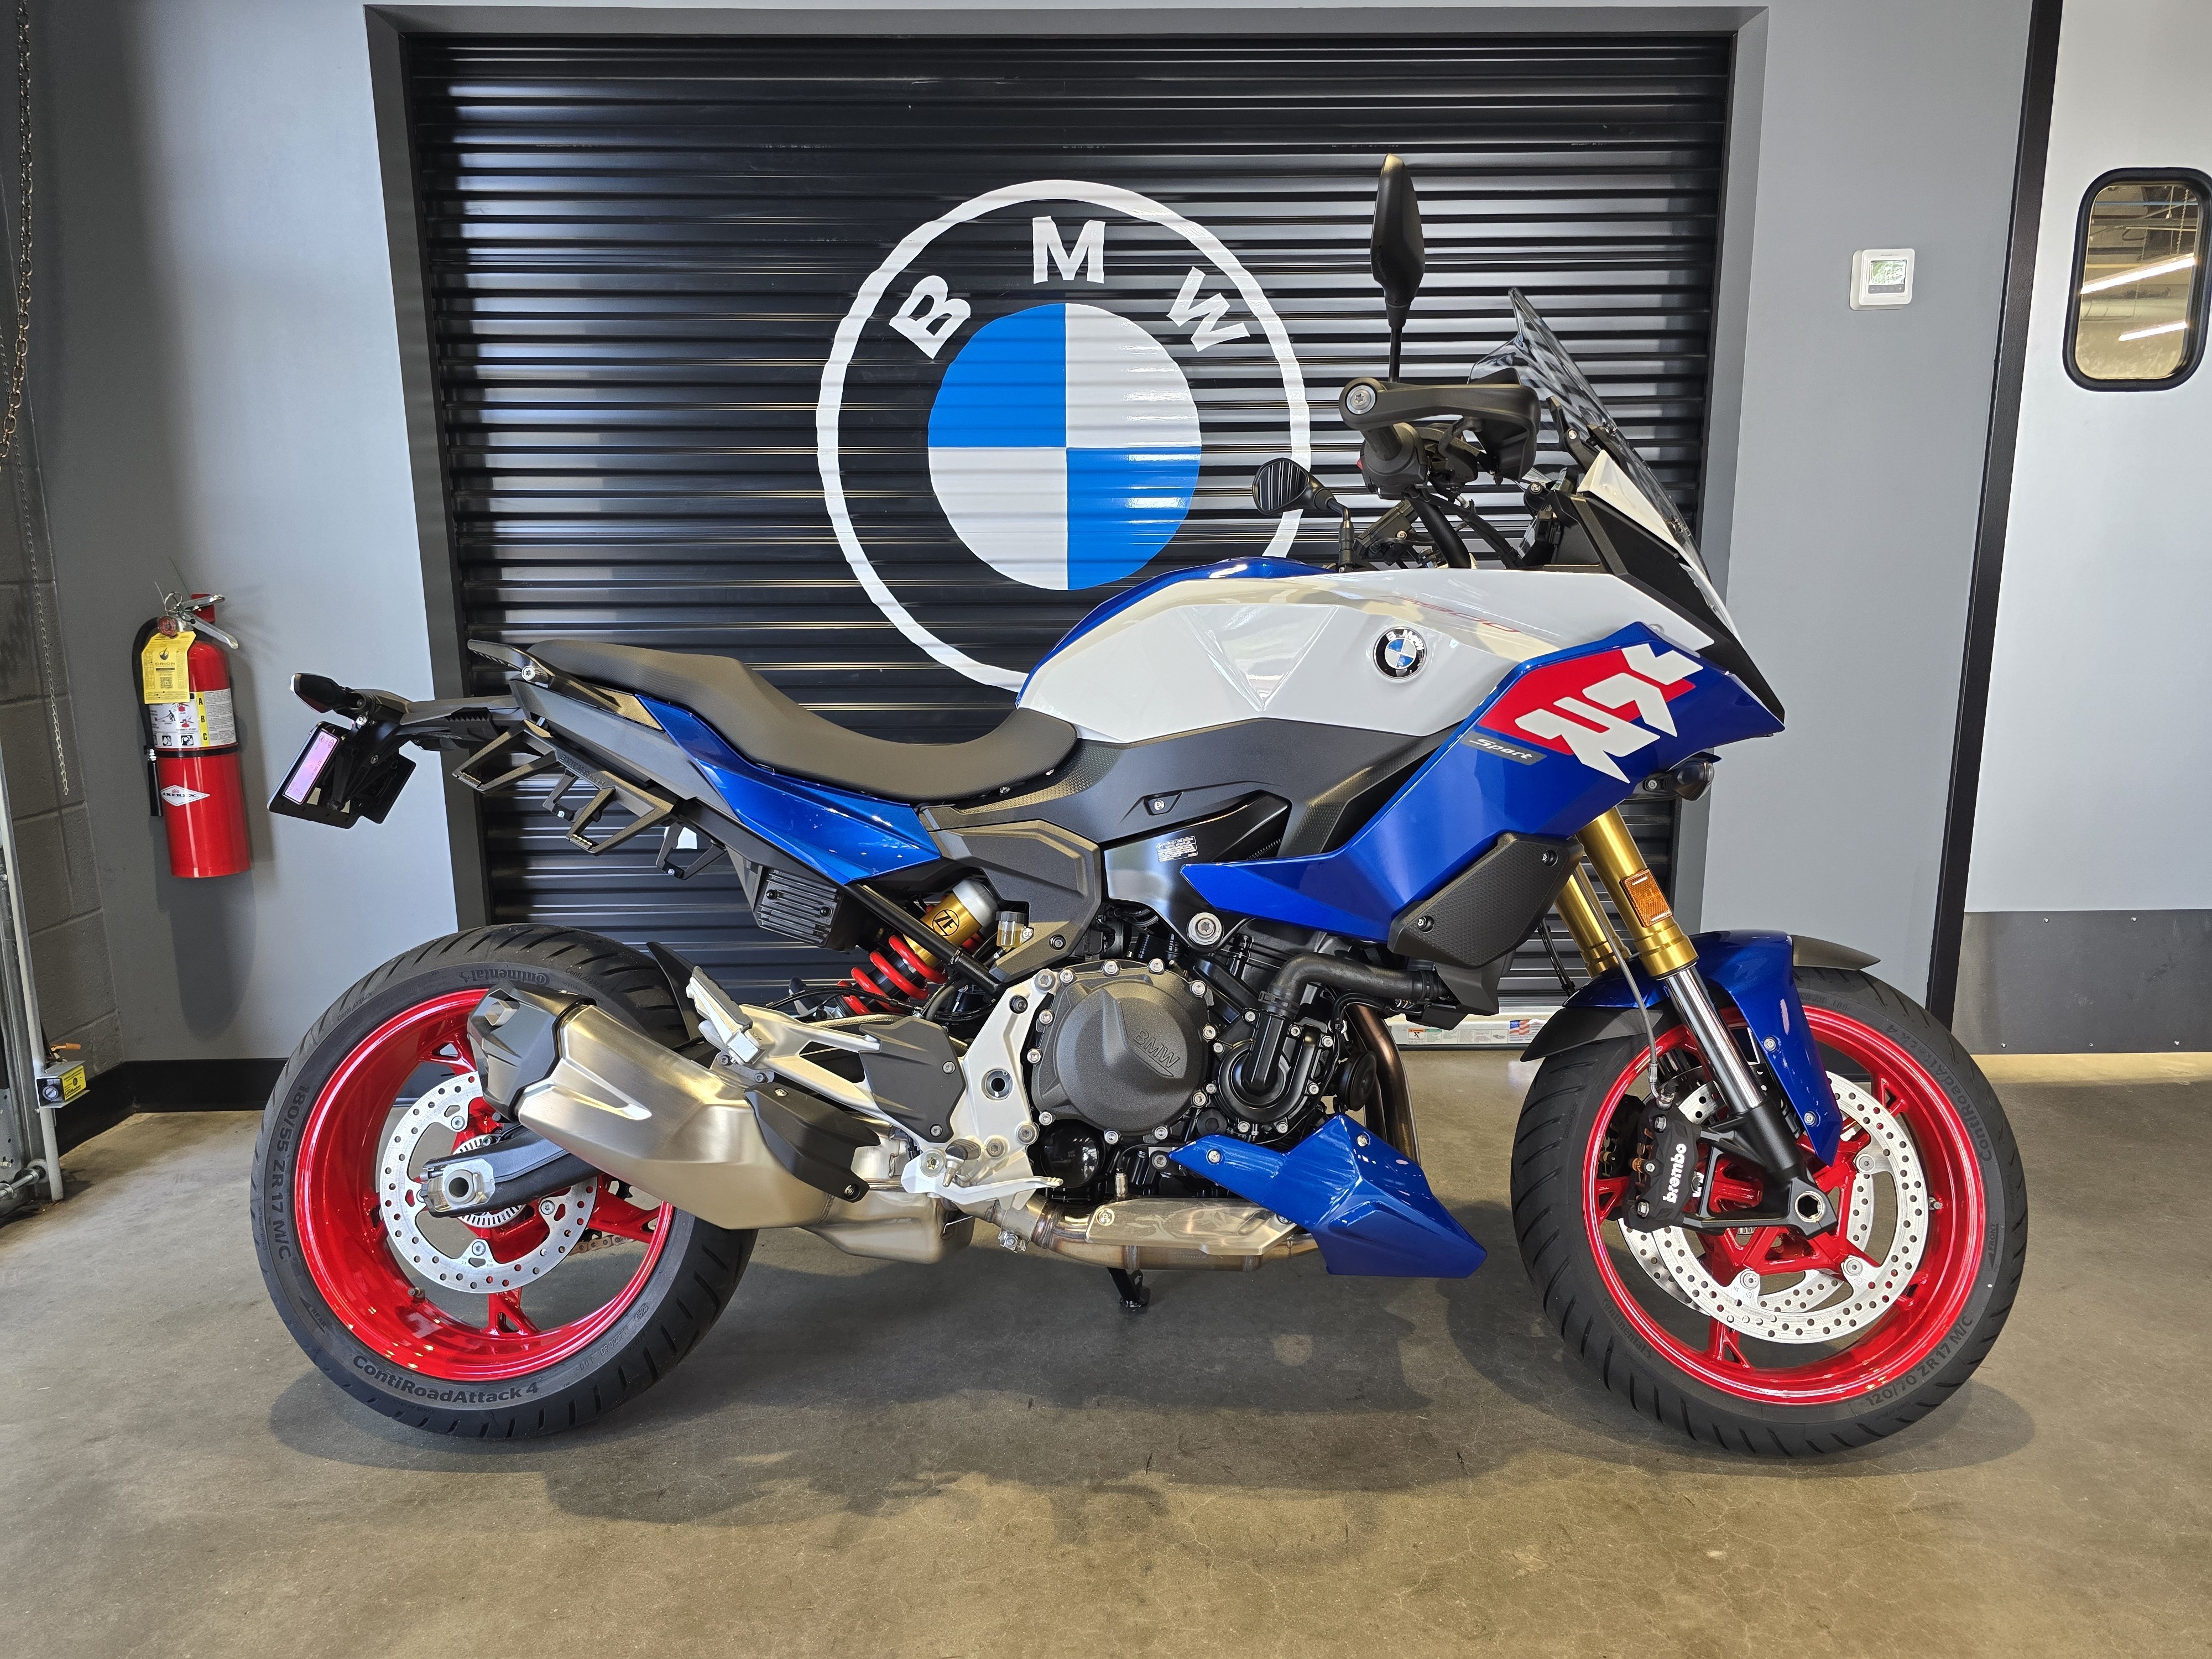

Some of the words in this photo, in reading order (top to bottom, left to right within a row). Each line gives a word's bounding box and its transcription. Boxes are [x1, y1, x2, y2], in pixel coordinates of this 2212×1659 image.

[889, 216, 1250, 359] BMW
[1385, 629, 1425, 650] BMW
[1469, 738, 1533, 759] Sport
[933, 910, 958, 936] ZF
[471, 969, 550, 986] Continental
[1132, 1027, 1180, 1068] BMW
[276, 1085, 310, 1152] 180/55
[1662, 1143, 1687, 1203] brembo
[273, 1219, 291, 1260] M/C
[1987, 1223, 1997, 1251] FRONT
[311, 1308, 327, 1328] REAR
[353, 1355, 523, 1404] ContiRoadAttack
[526, 1381, 540, 1394] 4
[1865, 1375, 1917, 1406] 120/70
[1949, 1315, 1973, 1345] M/C
